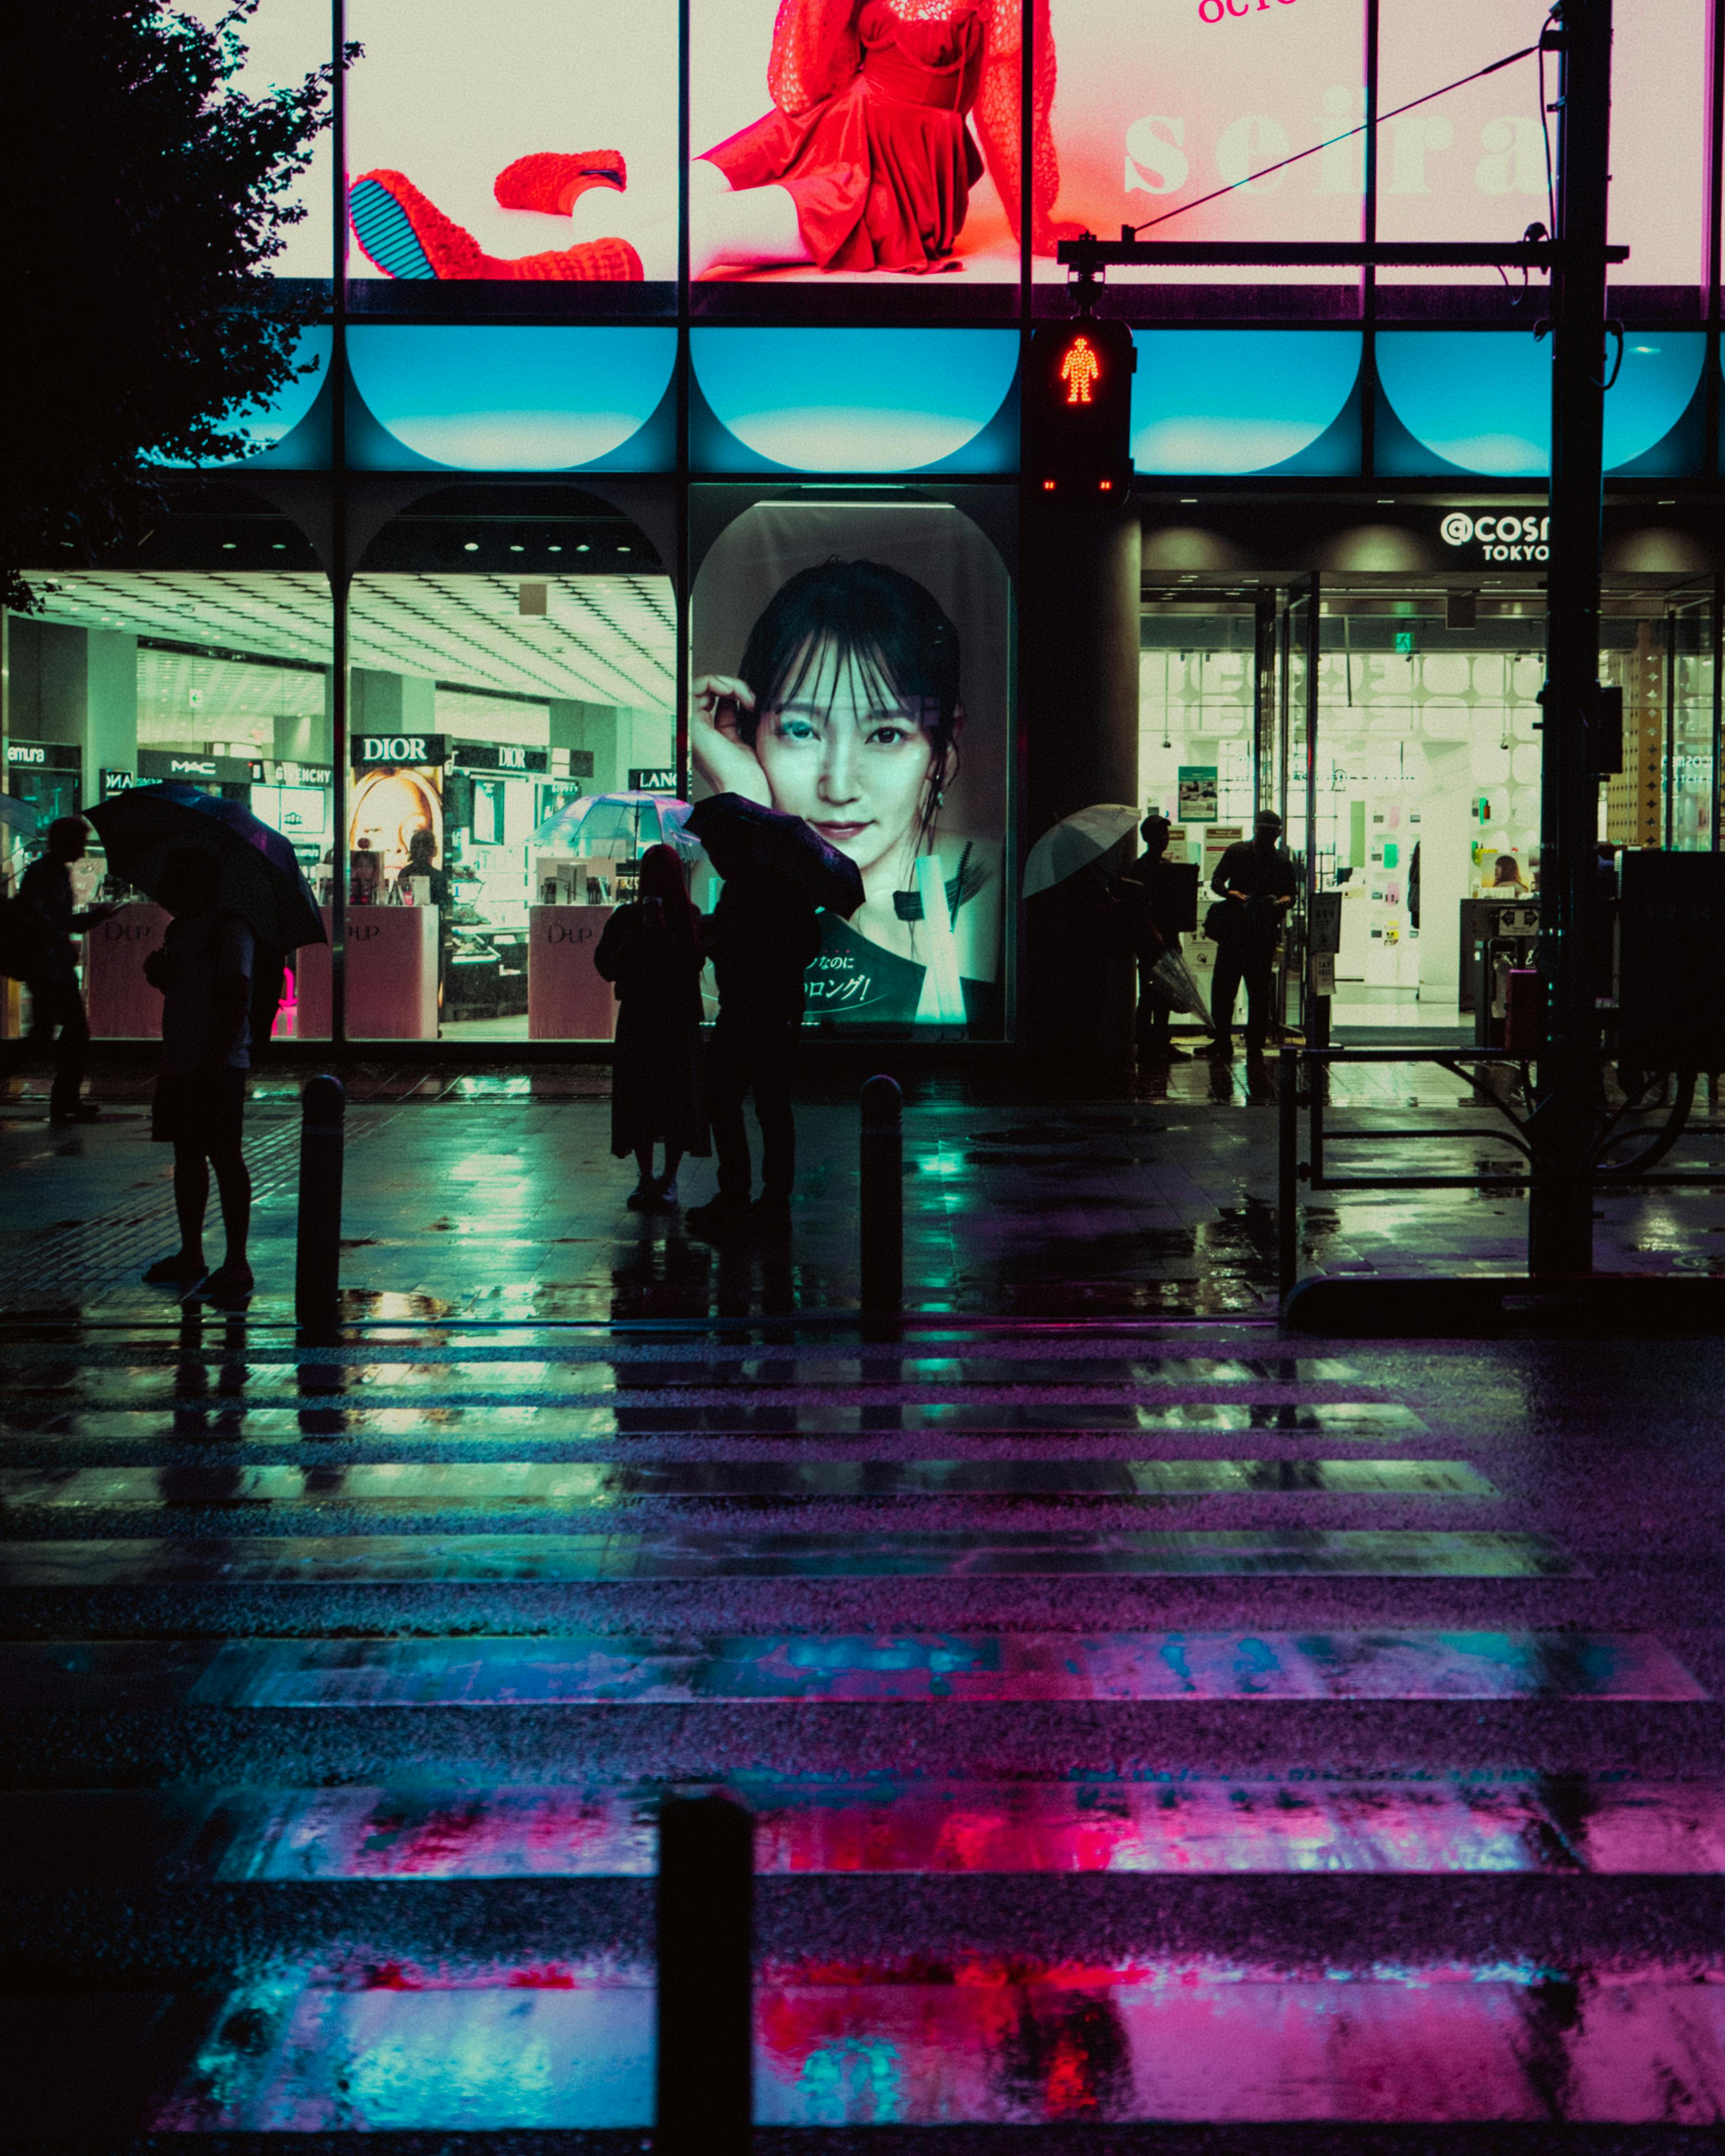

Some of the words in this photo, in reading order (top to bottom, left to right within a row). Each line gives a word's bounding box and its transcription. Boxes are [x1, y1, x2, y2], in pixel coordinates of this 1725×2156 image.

[1199, 0, 1296, 23] OC
[1124, 85, 1551, 196] seira
[1482, 545, 1549, 561] TOKYO
[363, 738, 427, 761] DIOR
[498, 746, 526, 769] DIOR
[172, 760, 216, 775] MAC
